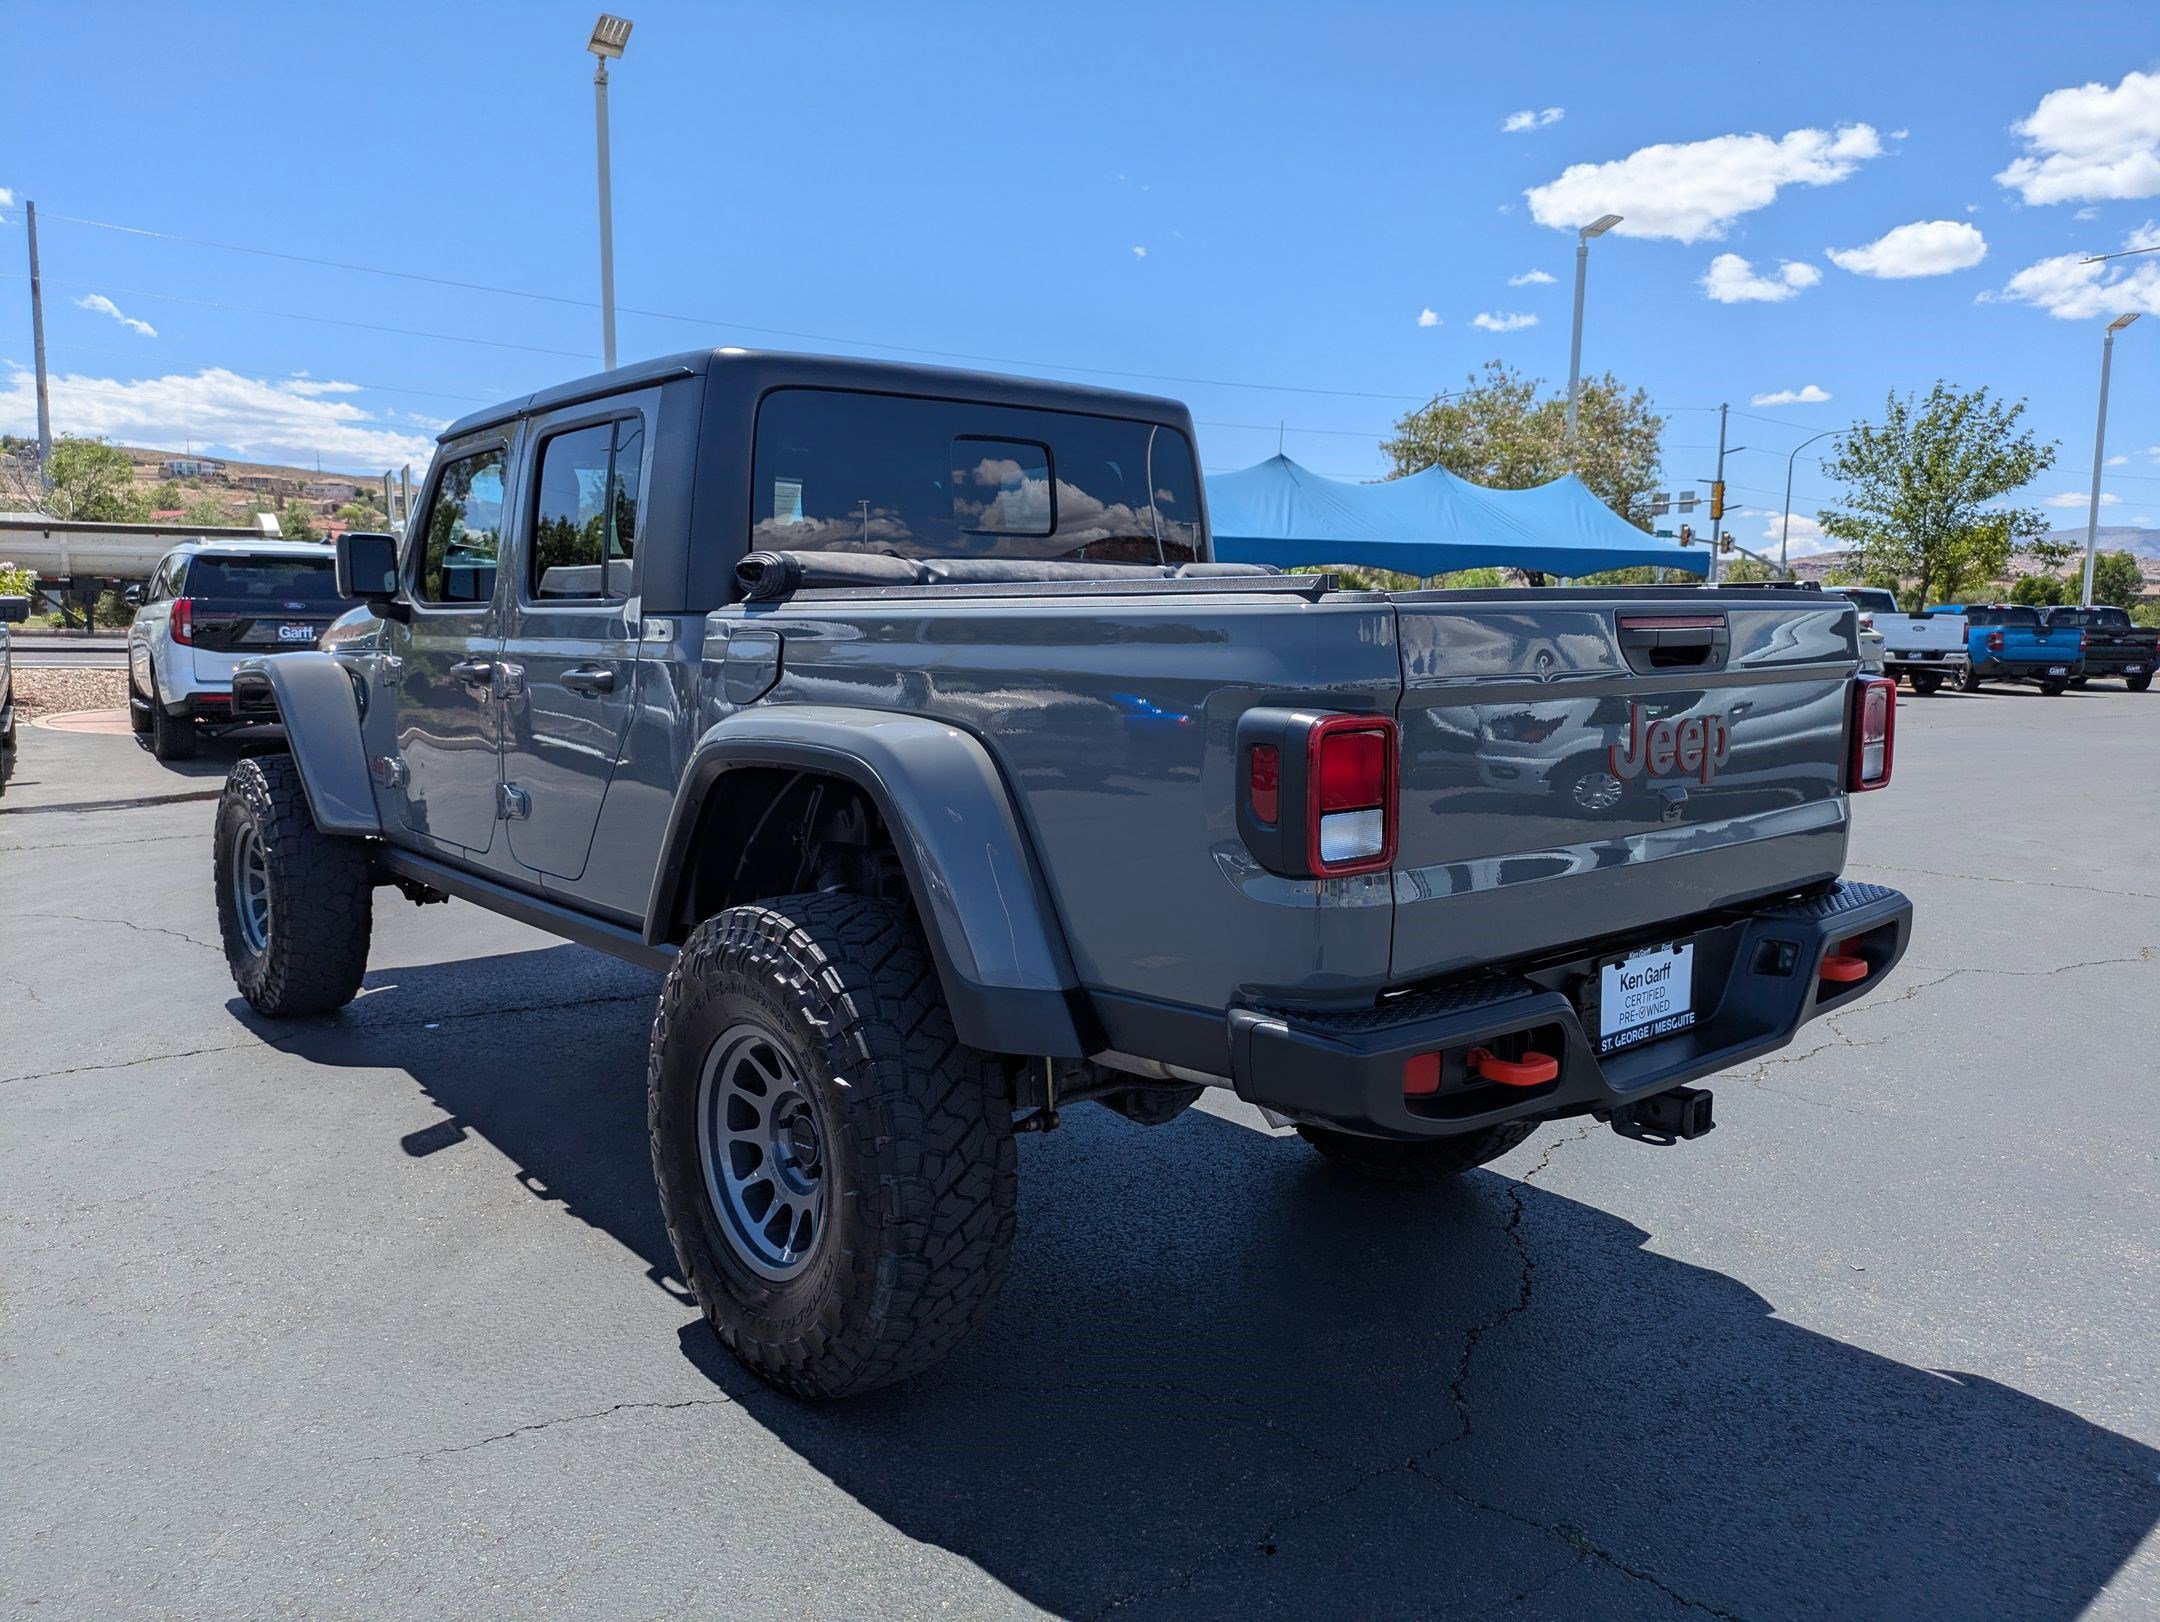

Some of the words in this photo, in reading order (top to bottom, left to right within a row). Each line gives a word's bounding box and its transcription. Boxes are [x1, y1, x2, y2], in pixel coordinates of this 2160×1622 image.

[278, 626, 314, 639] Garff
[1608, 703, 1732, 785] Jeep
[1619, 972, 1643, 992] Ken
[1645, 962, 1672, 985] Garff
[1625, 986, 1666, 1008] CERTIFIED
[1619, 1000, 1670, 1025] PRE-OWNED
[1601, 1037, 1613, 1052] ST.
[1614, 1026, 1649, 1047] GEORGE
[1655, 1012, 1696, 1034] MESQUITE
